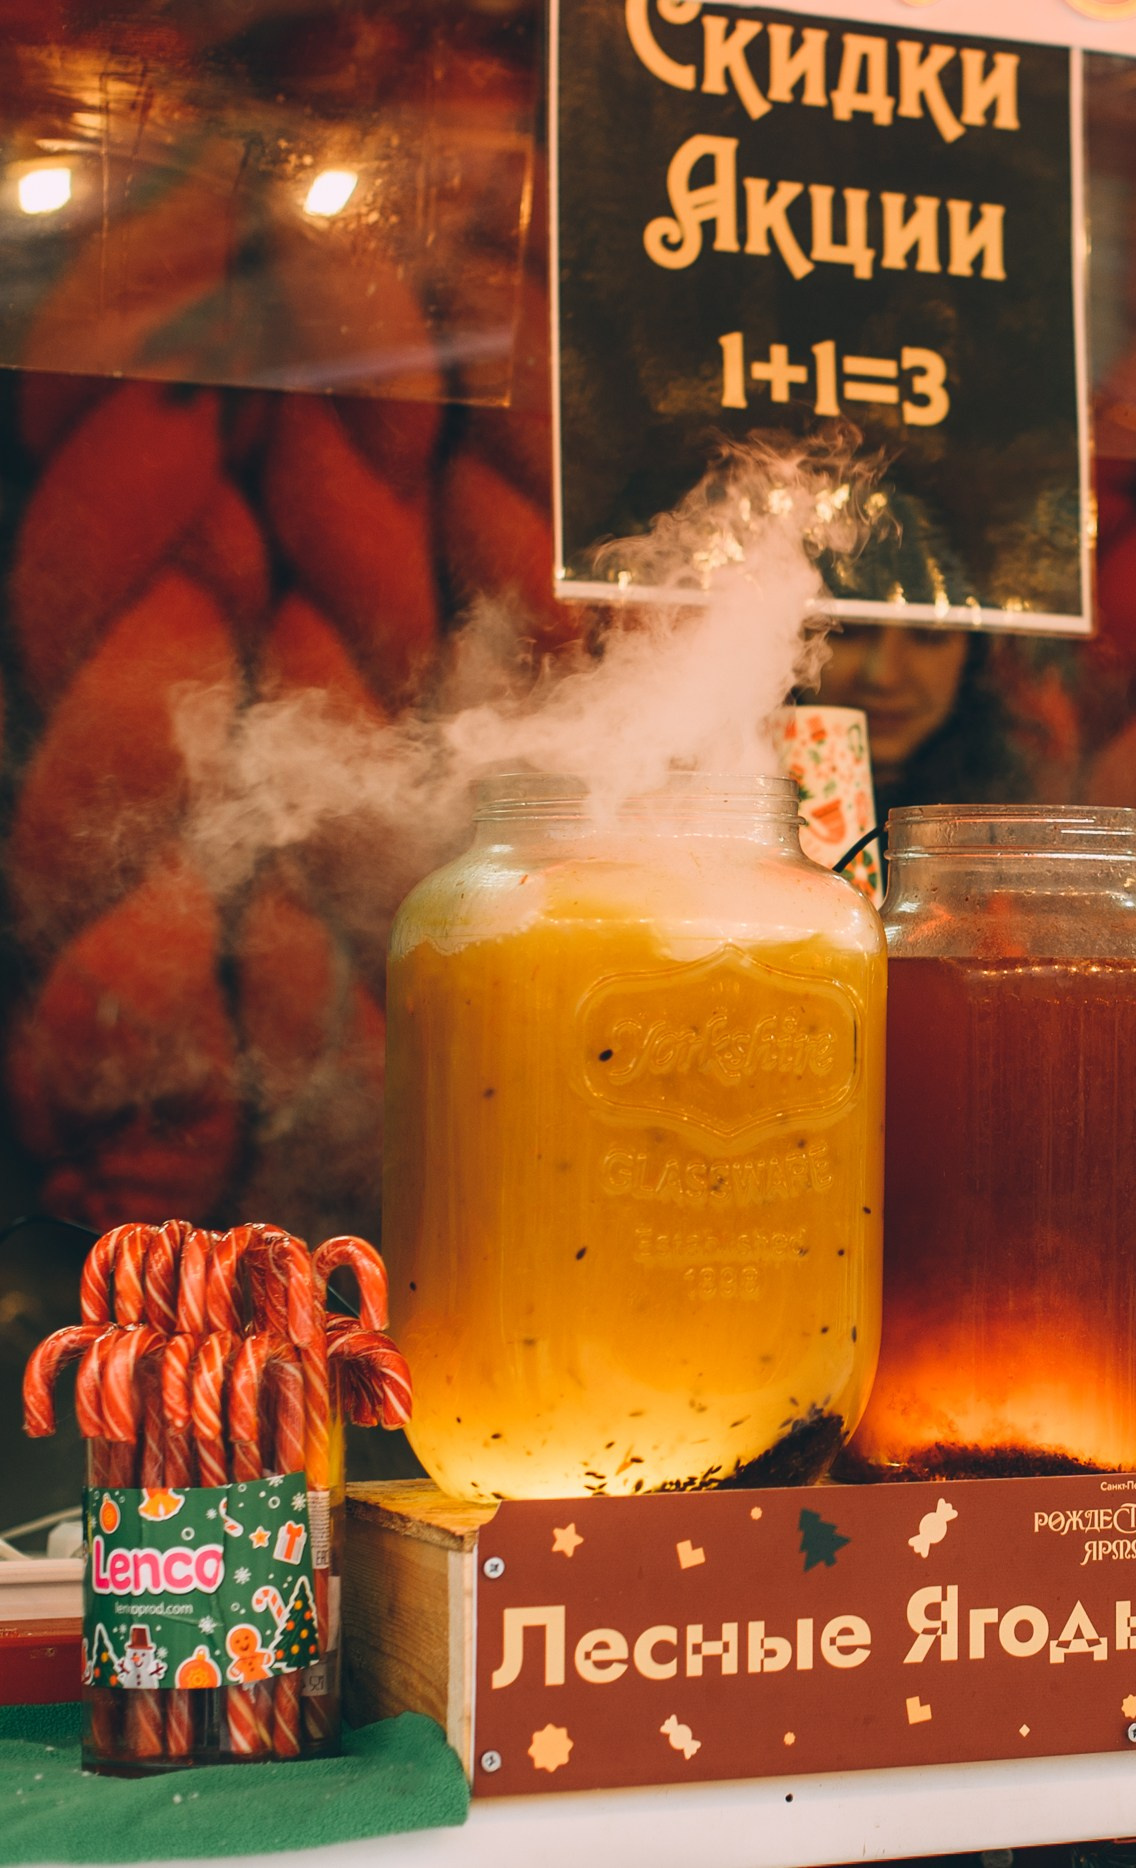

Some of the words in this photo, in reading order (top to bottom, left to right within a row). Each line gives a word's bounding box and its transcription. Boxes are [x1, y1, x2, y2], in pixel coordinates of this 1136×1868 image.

[626, 0, 1019, 143] Скидки
[643, 134, 1007, 282] Акции
[719, 331, 950, 427] 1+1=3
[600, 1143, 834, 1206] GLASSWARE
[93, 1537, 225, 1593] Lenco
[491, 1604, 872, 1690] Лесные
